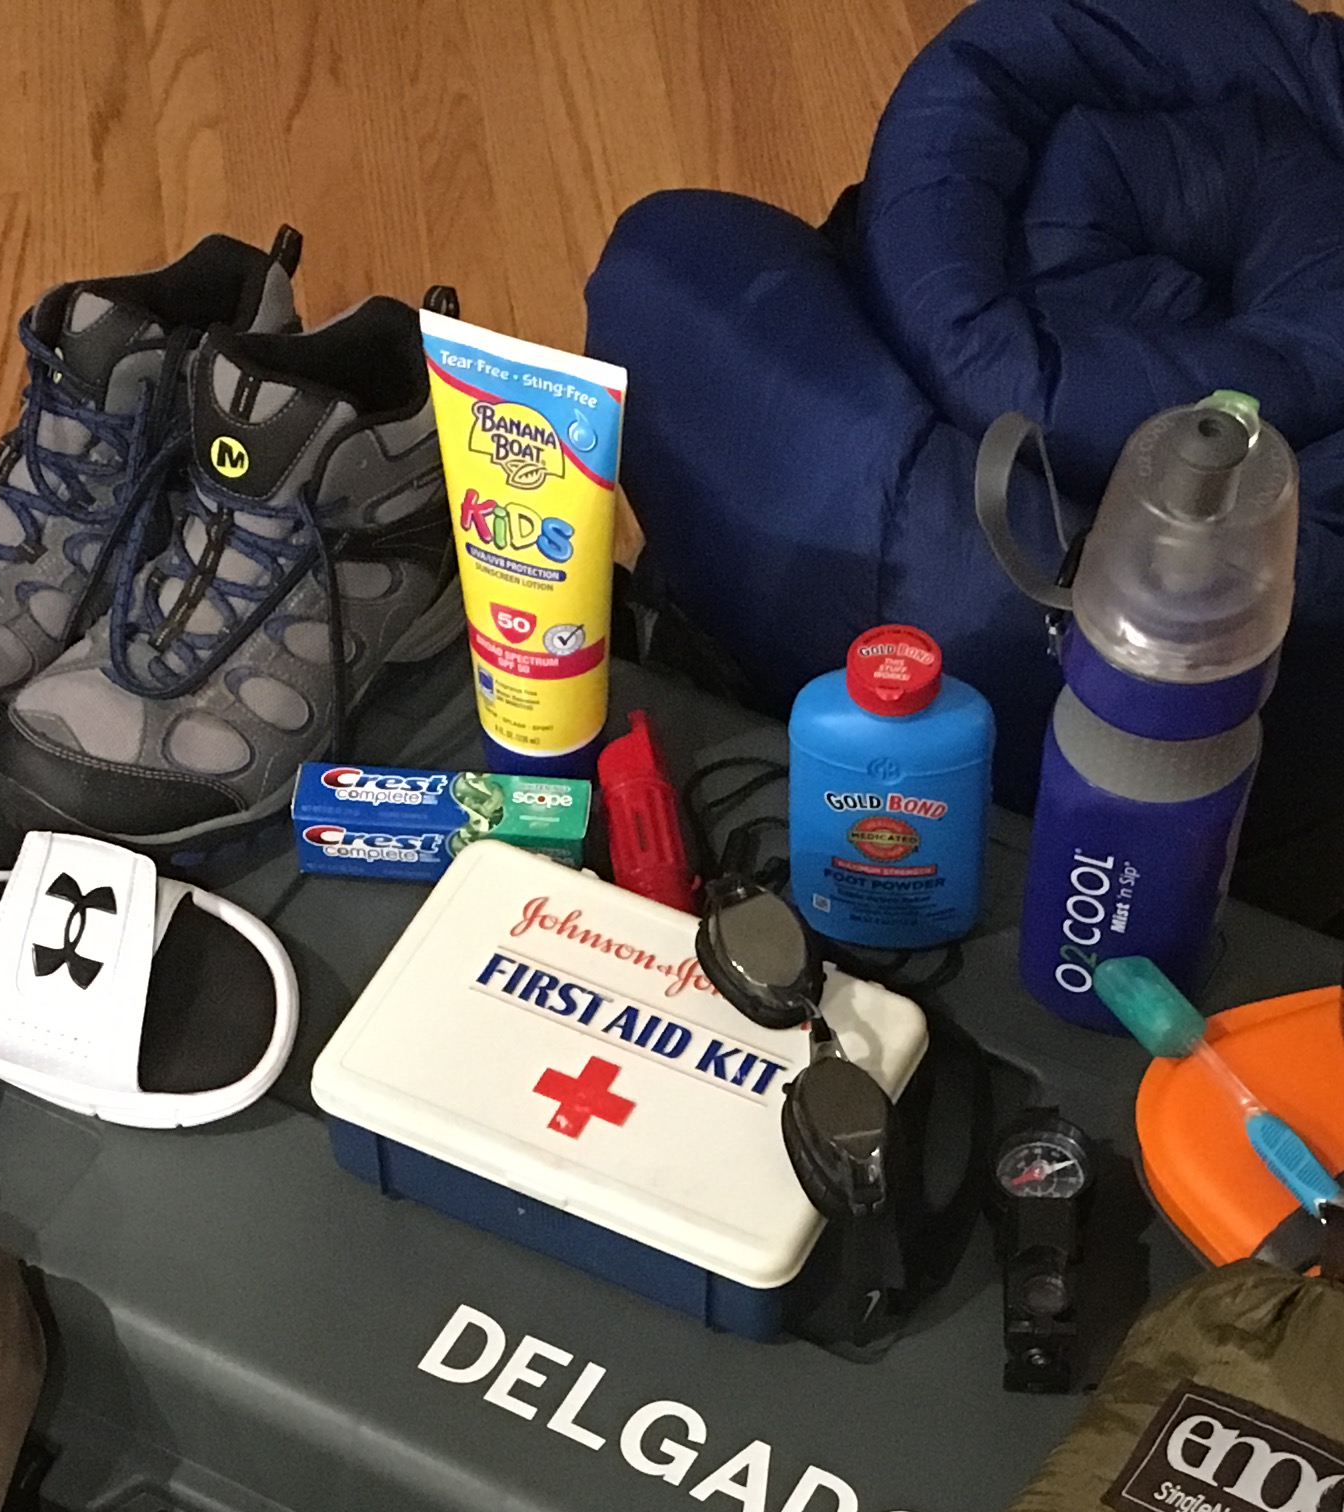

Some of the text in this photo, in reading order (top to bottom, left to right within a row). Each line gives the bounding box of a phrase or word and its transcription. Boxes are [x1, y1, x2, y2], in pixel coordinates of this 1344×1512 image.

[477, 404, 557, 449] BANANA
[491, 433, 544, 464] BOAT
[475, 562, 554, 592] SUNSCREEN LOTION
[506, 559, 560, 580] PROTECTION
[497, 611, 531, 633] 50
[504, 650, 560, 667] SPECTRUM
[859, 642, 935, 666] GOLD BOND
[322, 767, 446, 794] Crest
[336, 787, 420, 805] complete
[512, 791, 573, 809] scope
[825, 792, 948, 819] GOLD BOND
[304, 826, 443, 852] Crest
[851, 832, 918, 844] MEDICATED
[324, 846, 417, 862] complete
[824, 868, 946, 891] FOOT POWDER
[1119, 865, 1141, 887] Sip
[1110, 902, 1131, 934] Mist
[510, 896, 656, 970] Johnson
[476, 951, 616, 1026] FIRST
[603, 1005, 693, 1060] AID
[695, 1039, 789, 1096] KIT
